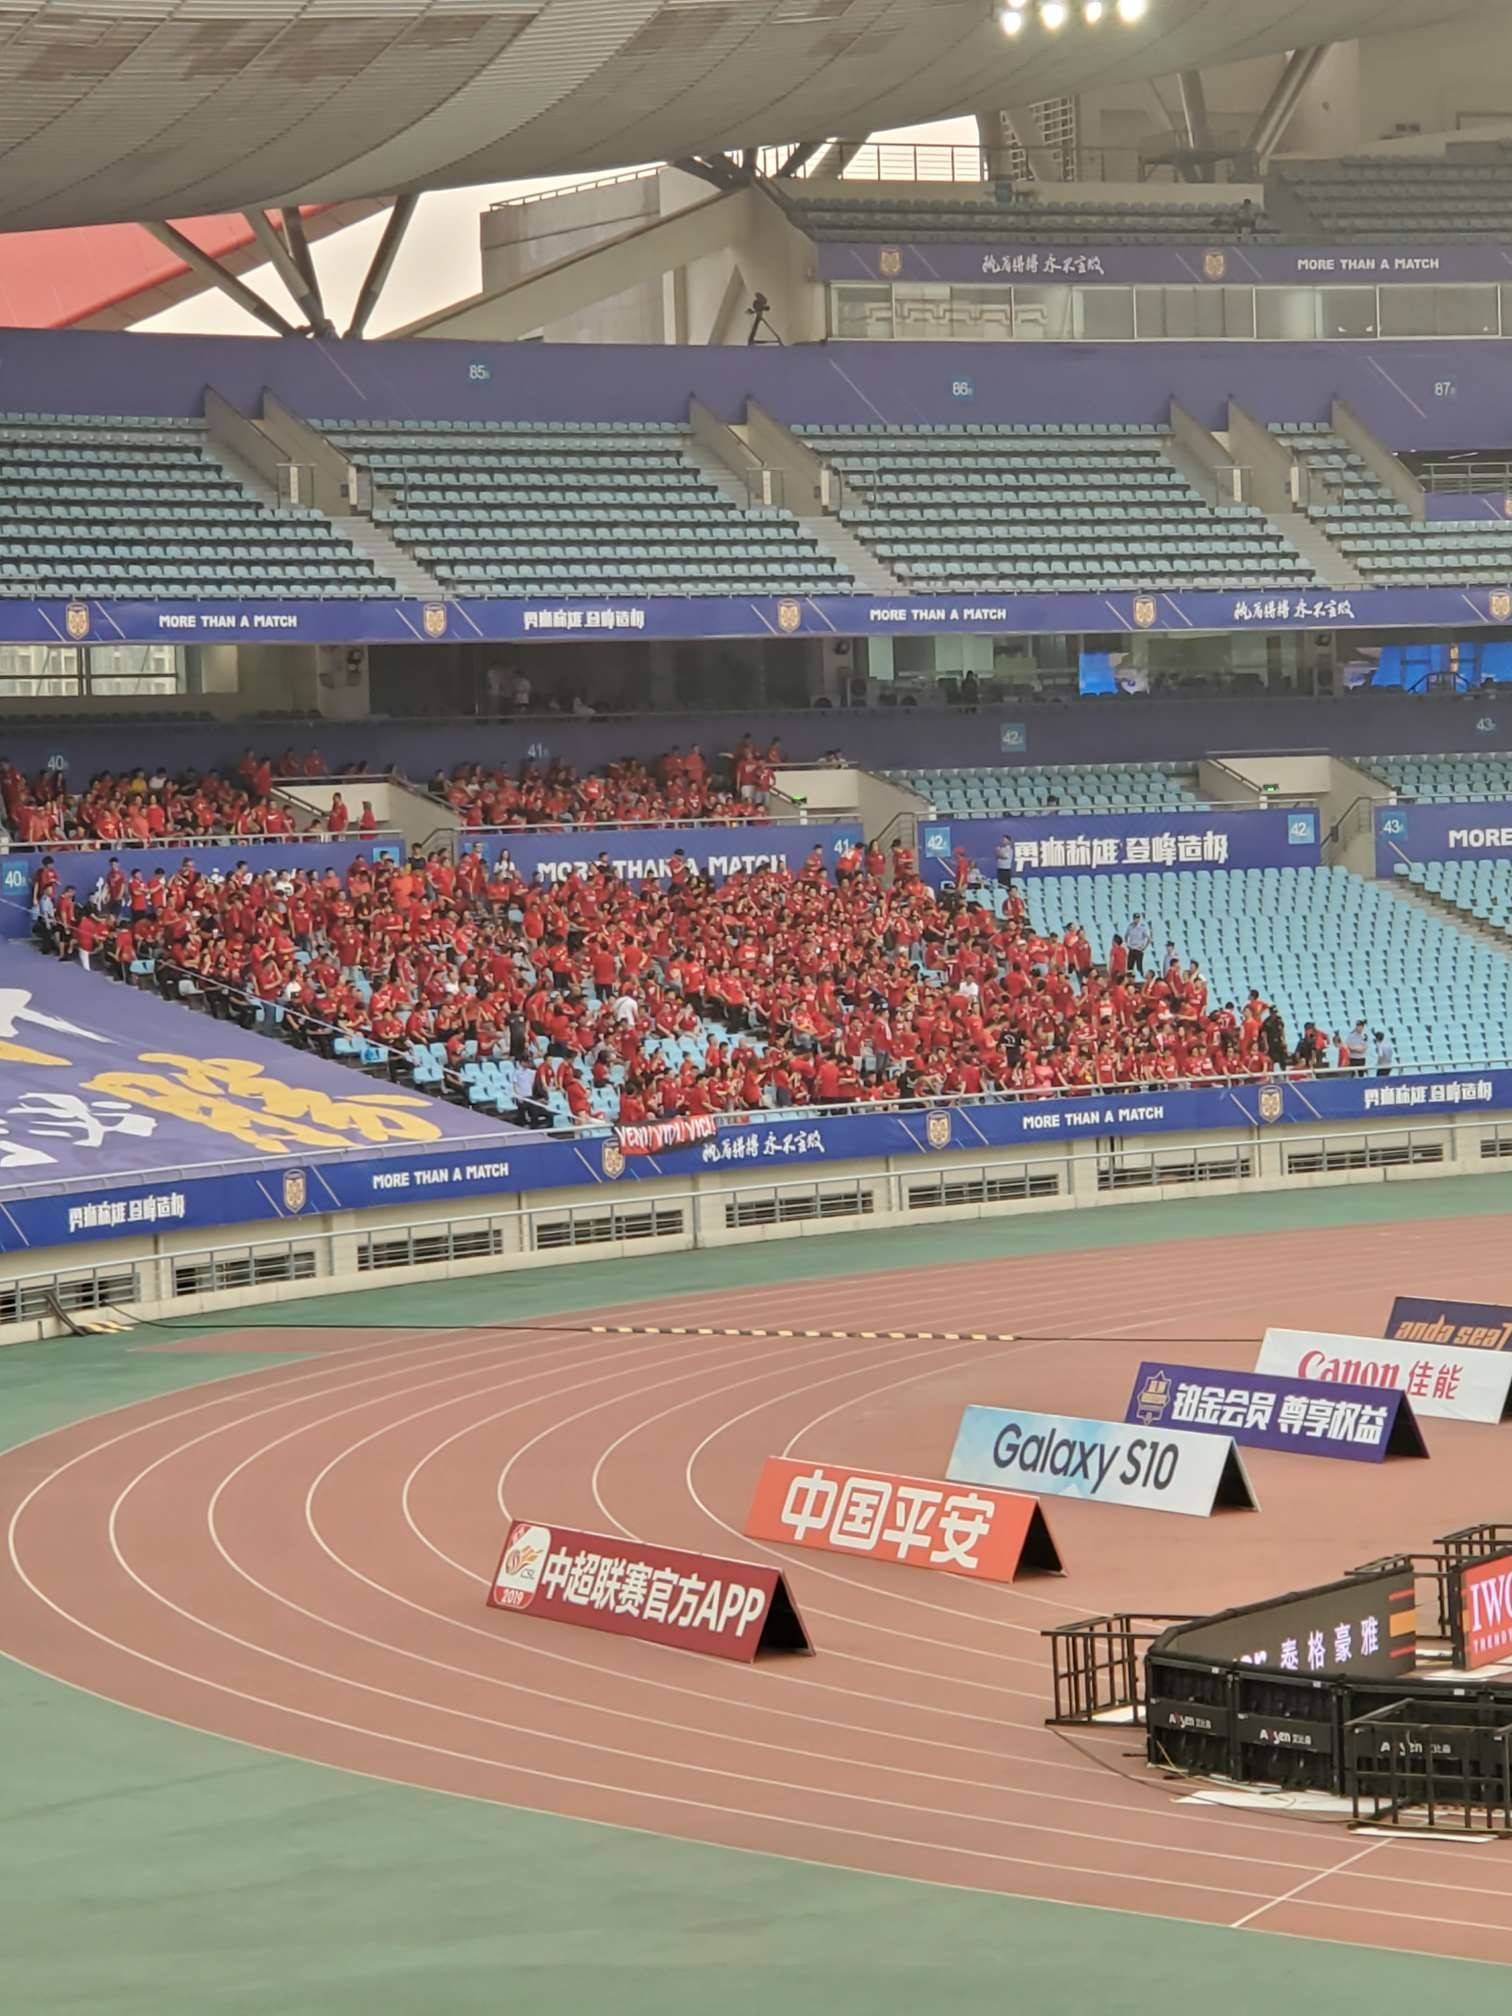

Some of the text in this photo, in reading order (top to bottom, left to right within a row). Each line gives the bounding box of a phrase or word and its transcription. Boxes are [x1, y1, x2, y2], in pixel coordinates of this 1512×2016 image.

[1297, 258, 1440, 270] MORE THAN A MATCH
[159, 615, 297, 628] MORE THAN A MATCH
[869, 608, 1007, 621] MORE THAN A MATCH
[1121, 830, 1229, 867] 登峰造极
[1448, 828, 1512, 848] MORE
[537, 861, 605, 883] MOR
[1022, 1105, 1164, 1130] MORE THAN A MATCH
[372, 1162, 509, 1190] MORE THAN A MATCH
[1394, 1313, 1456, 1344] anda
[1298, 1350, 1464, 1401] Canon 佳能
[1171, 1383, 1390, 1445] 铂金会员 尊享权益
[992, 1423, 1181, 1494] Galaxy S10
[780, 1469, 997, 1570] 中国平安
[501, 1588, 525, 1606] 2019
[541, 1547, 766, 1638] 中超联赛官方APP
[1280, 1616, 1380, 1671] 泰格豪雅
